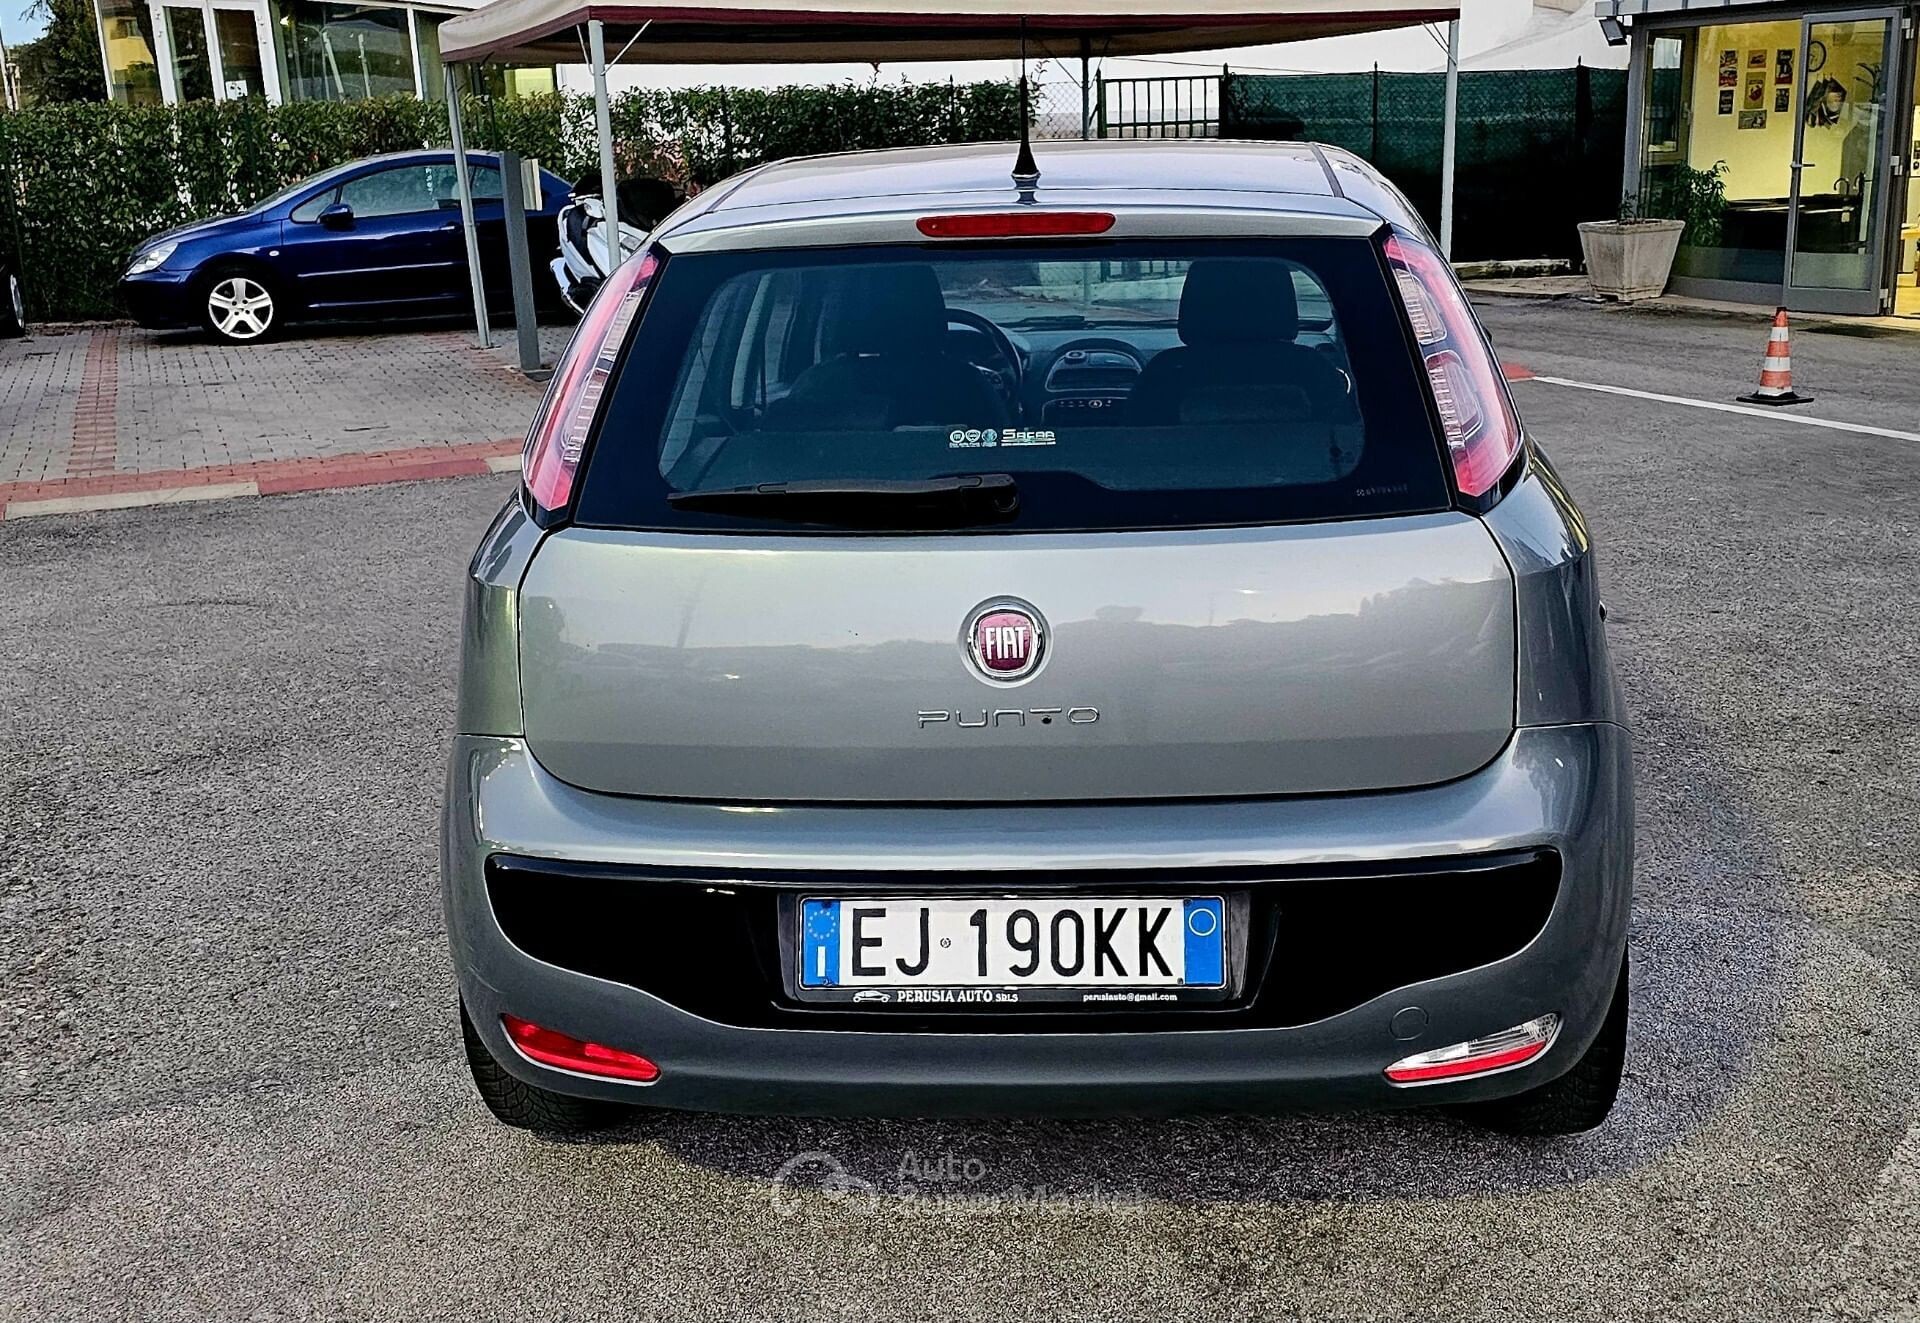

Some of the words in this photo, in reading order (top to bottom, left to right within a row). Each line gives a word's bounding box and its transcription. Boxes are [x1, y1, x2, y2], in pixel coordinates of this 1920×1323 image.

[984, 625, 1028, 660] FIAT
[917, 706, 1100, 729] PUNTO
[851, 906, 930, 977] EJ
[969, 906, 1174, 977] 190KK
[896, 989, 953, 1003] PERUSIA
[957, 989, 994, 1003] AUTO
